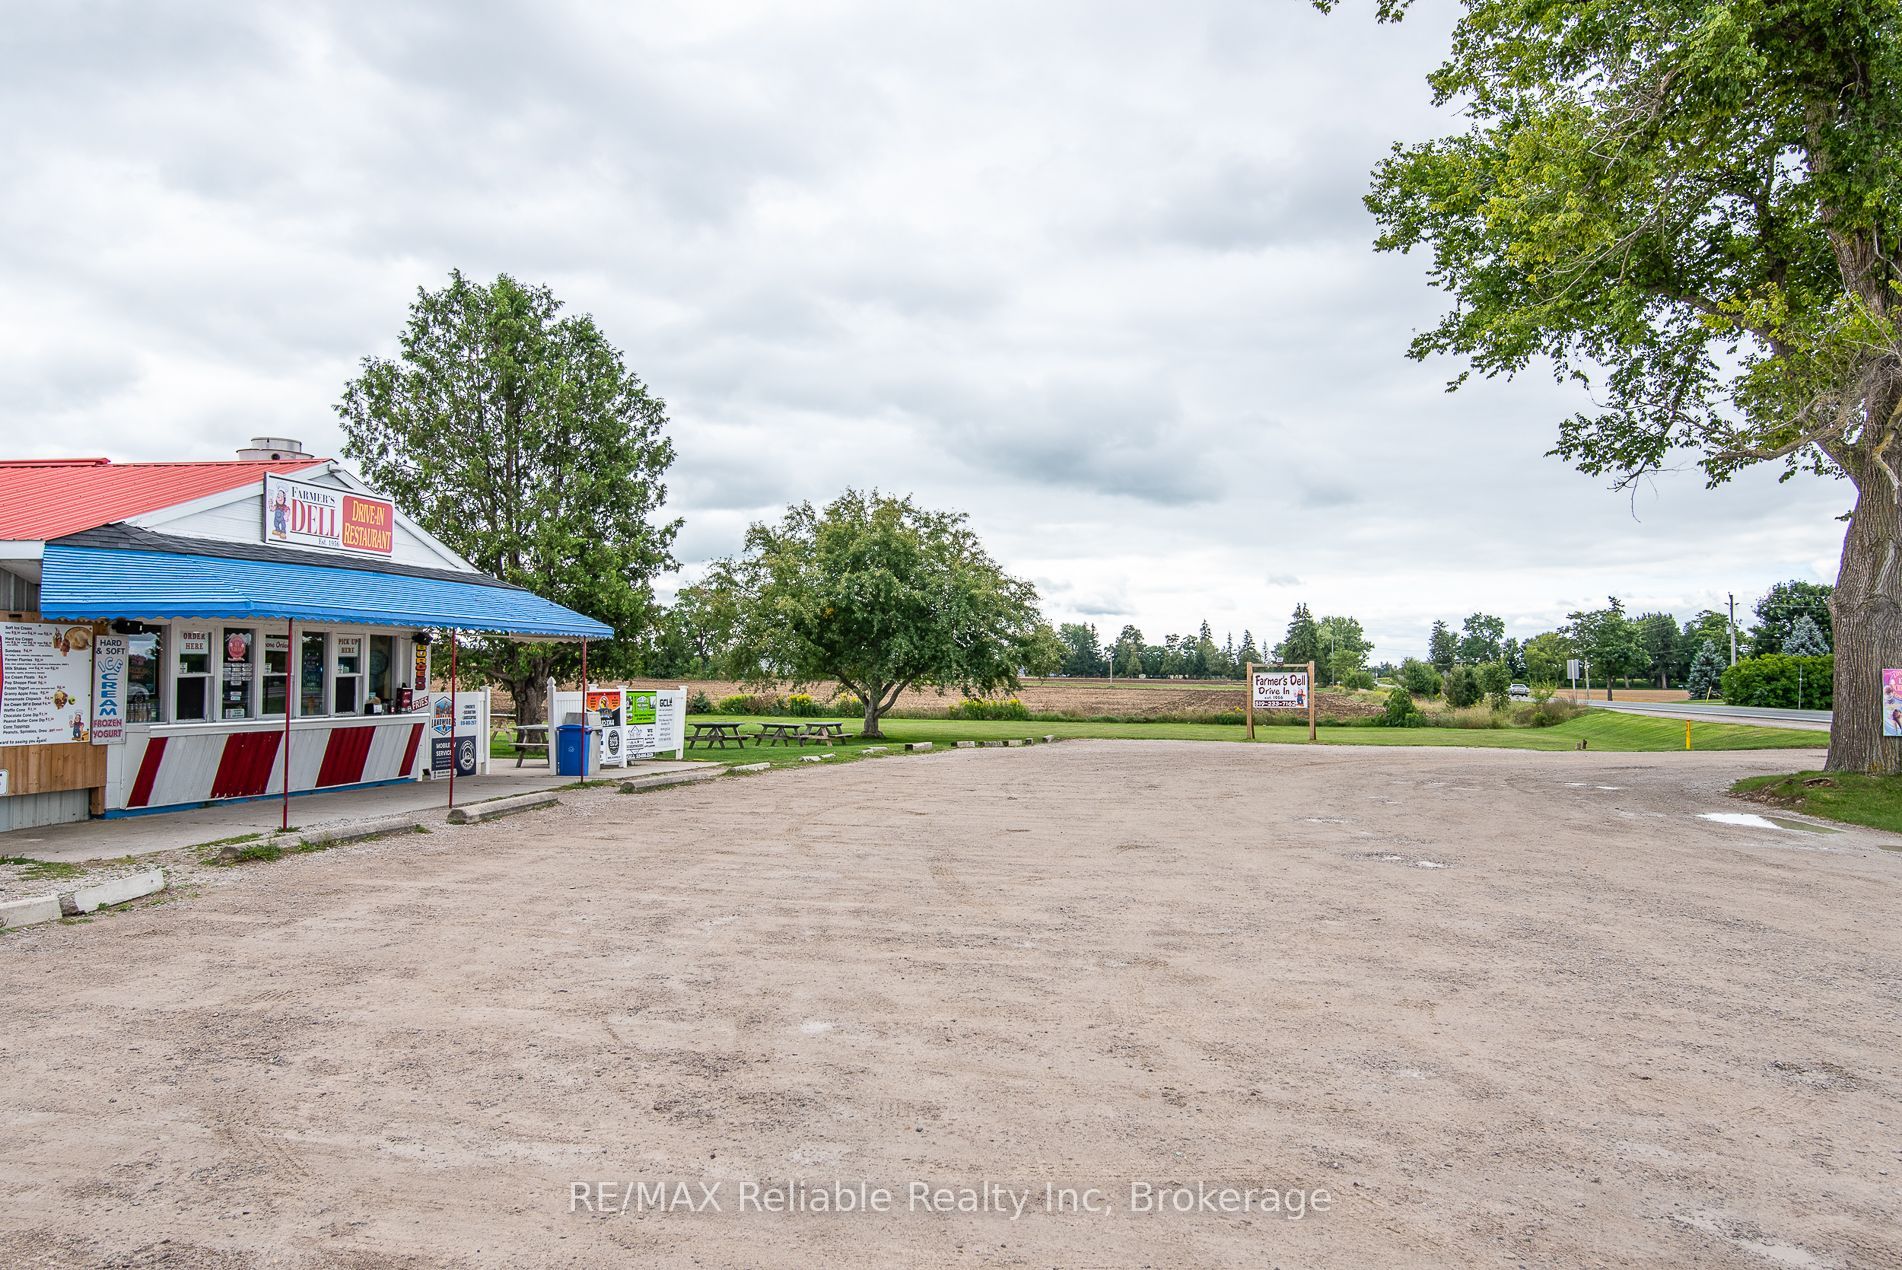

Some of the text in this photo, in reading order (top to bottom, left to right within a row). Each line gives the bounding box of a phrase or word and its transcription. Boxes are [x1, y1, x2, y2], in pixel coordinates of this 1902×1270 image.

[292, 486, 336, 504] FARMER'S
[291, 499, 340, 538] DELL
[352, 500, 385, 526] DRIVE-IN
[344, 523, 391, 550] RESTAURANT
[183, 632, 206, 640] ORDER
[185, 642, 204, 650] HERE
[98, 656, 123, 673] ICE
[1255, 674, 1306, 686] Farmer's Dell
[99, 673, 118, 716] CREAM
[1258, 687, 1290, 695] Drive In
[412, 696, 429, 710] FRIES
[93, 718, 122, 728] FROZEN
[93, 730, 122, 738] YOGURT
